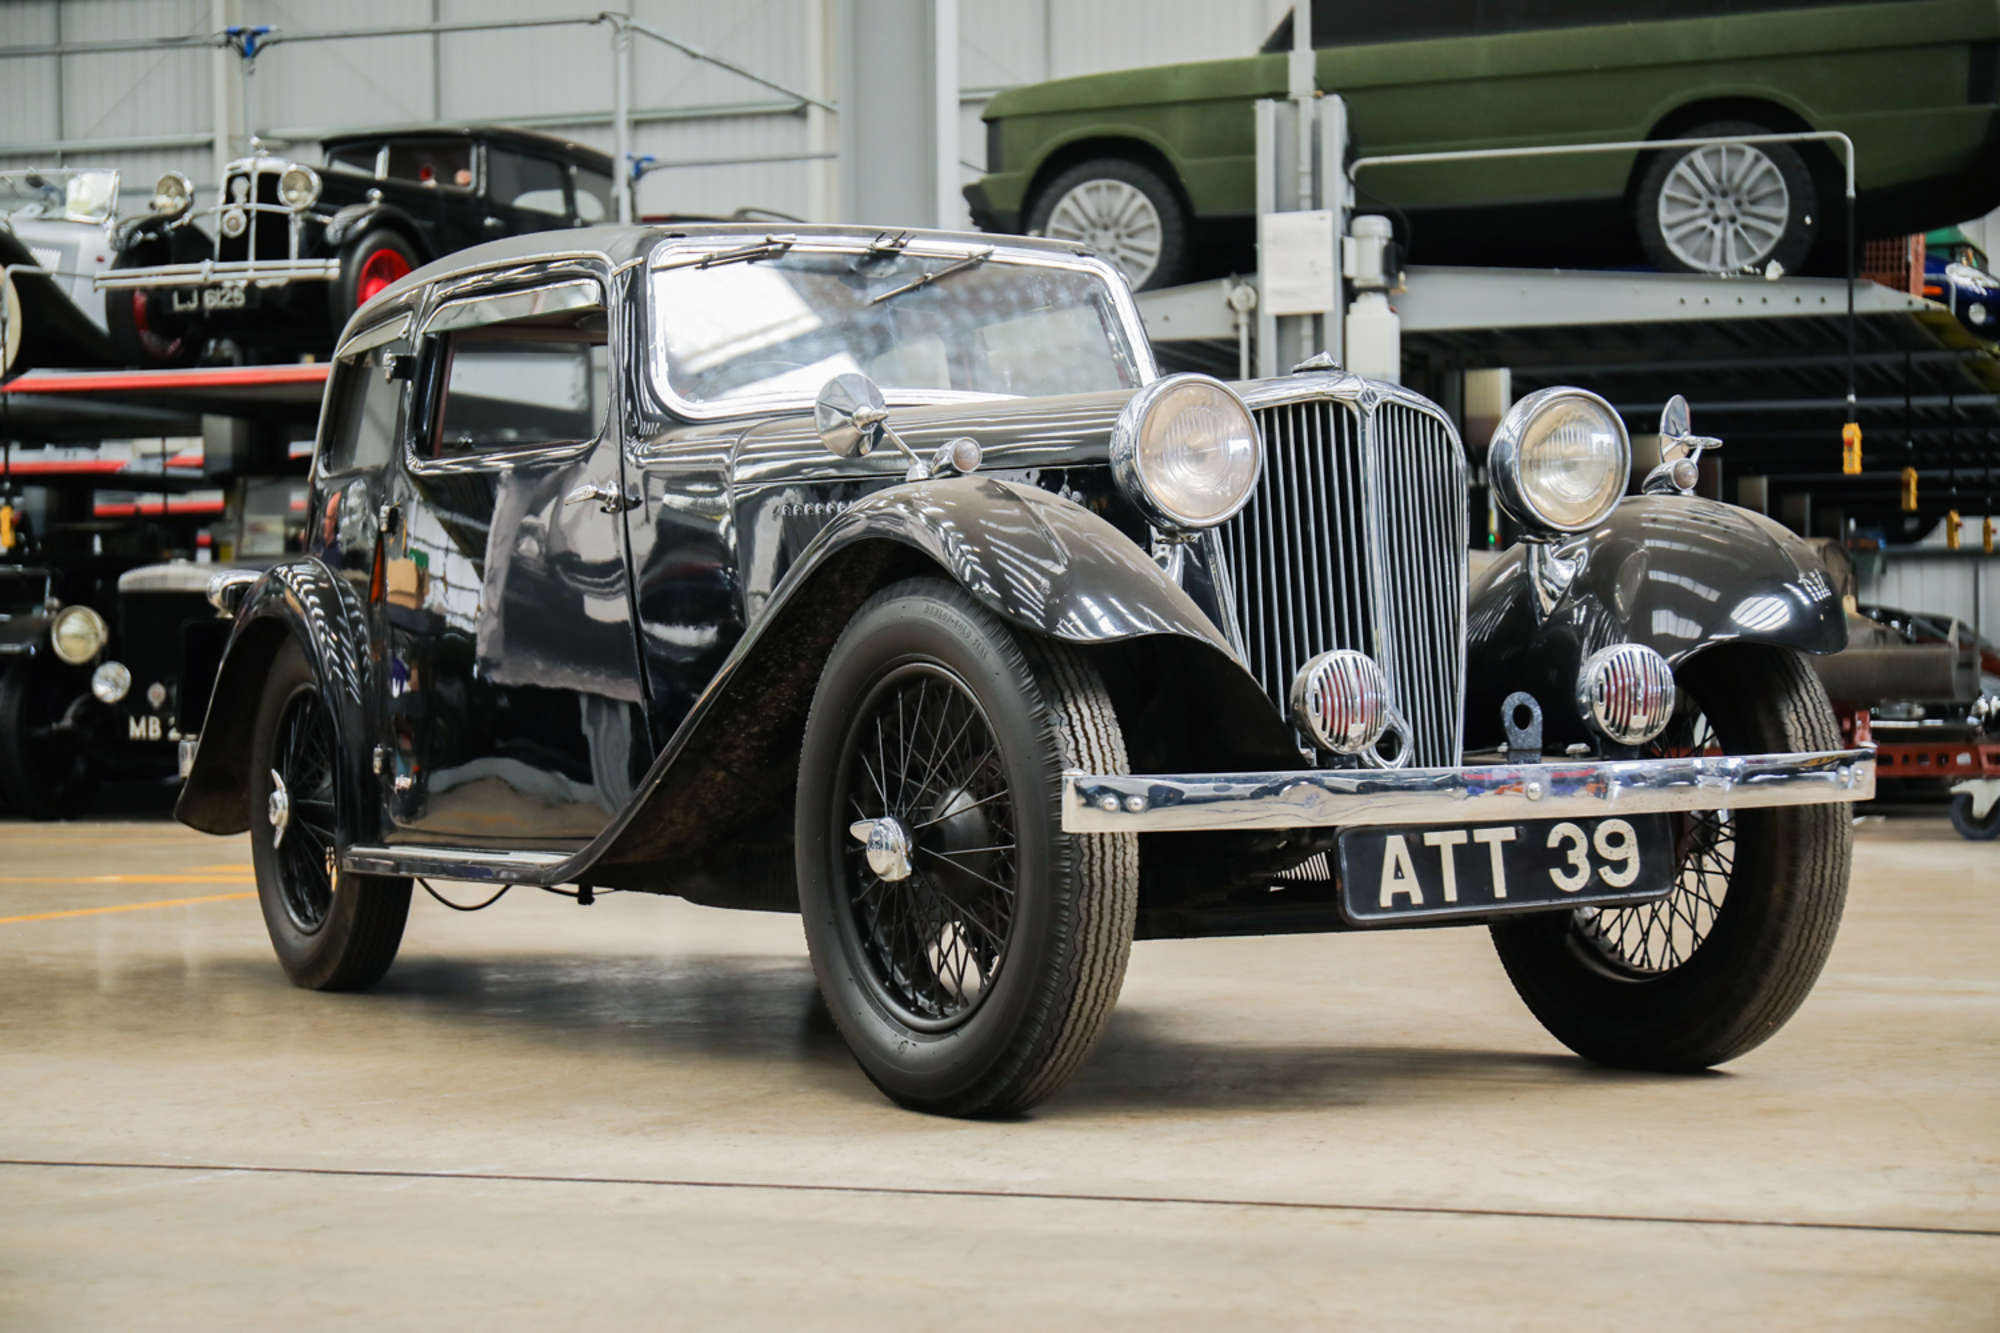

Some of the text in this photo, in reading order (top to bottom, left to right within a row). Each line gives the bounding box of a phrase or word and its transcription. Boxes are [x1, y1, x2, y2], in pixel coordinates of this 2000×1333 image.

[172, 288, 199, 312] LJ
[128, 714, 162, 741] MB
[1379, 819, 1641, 908] ATT 39
